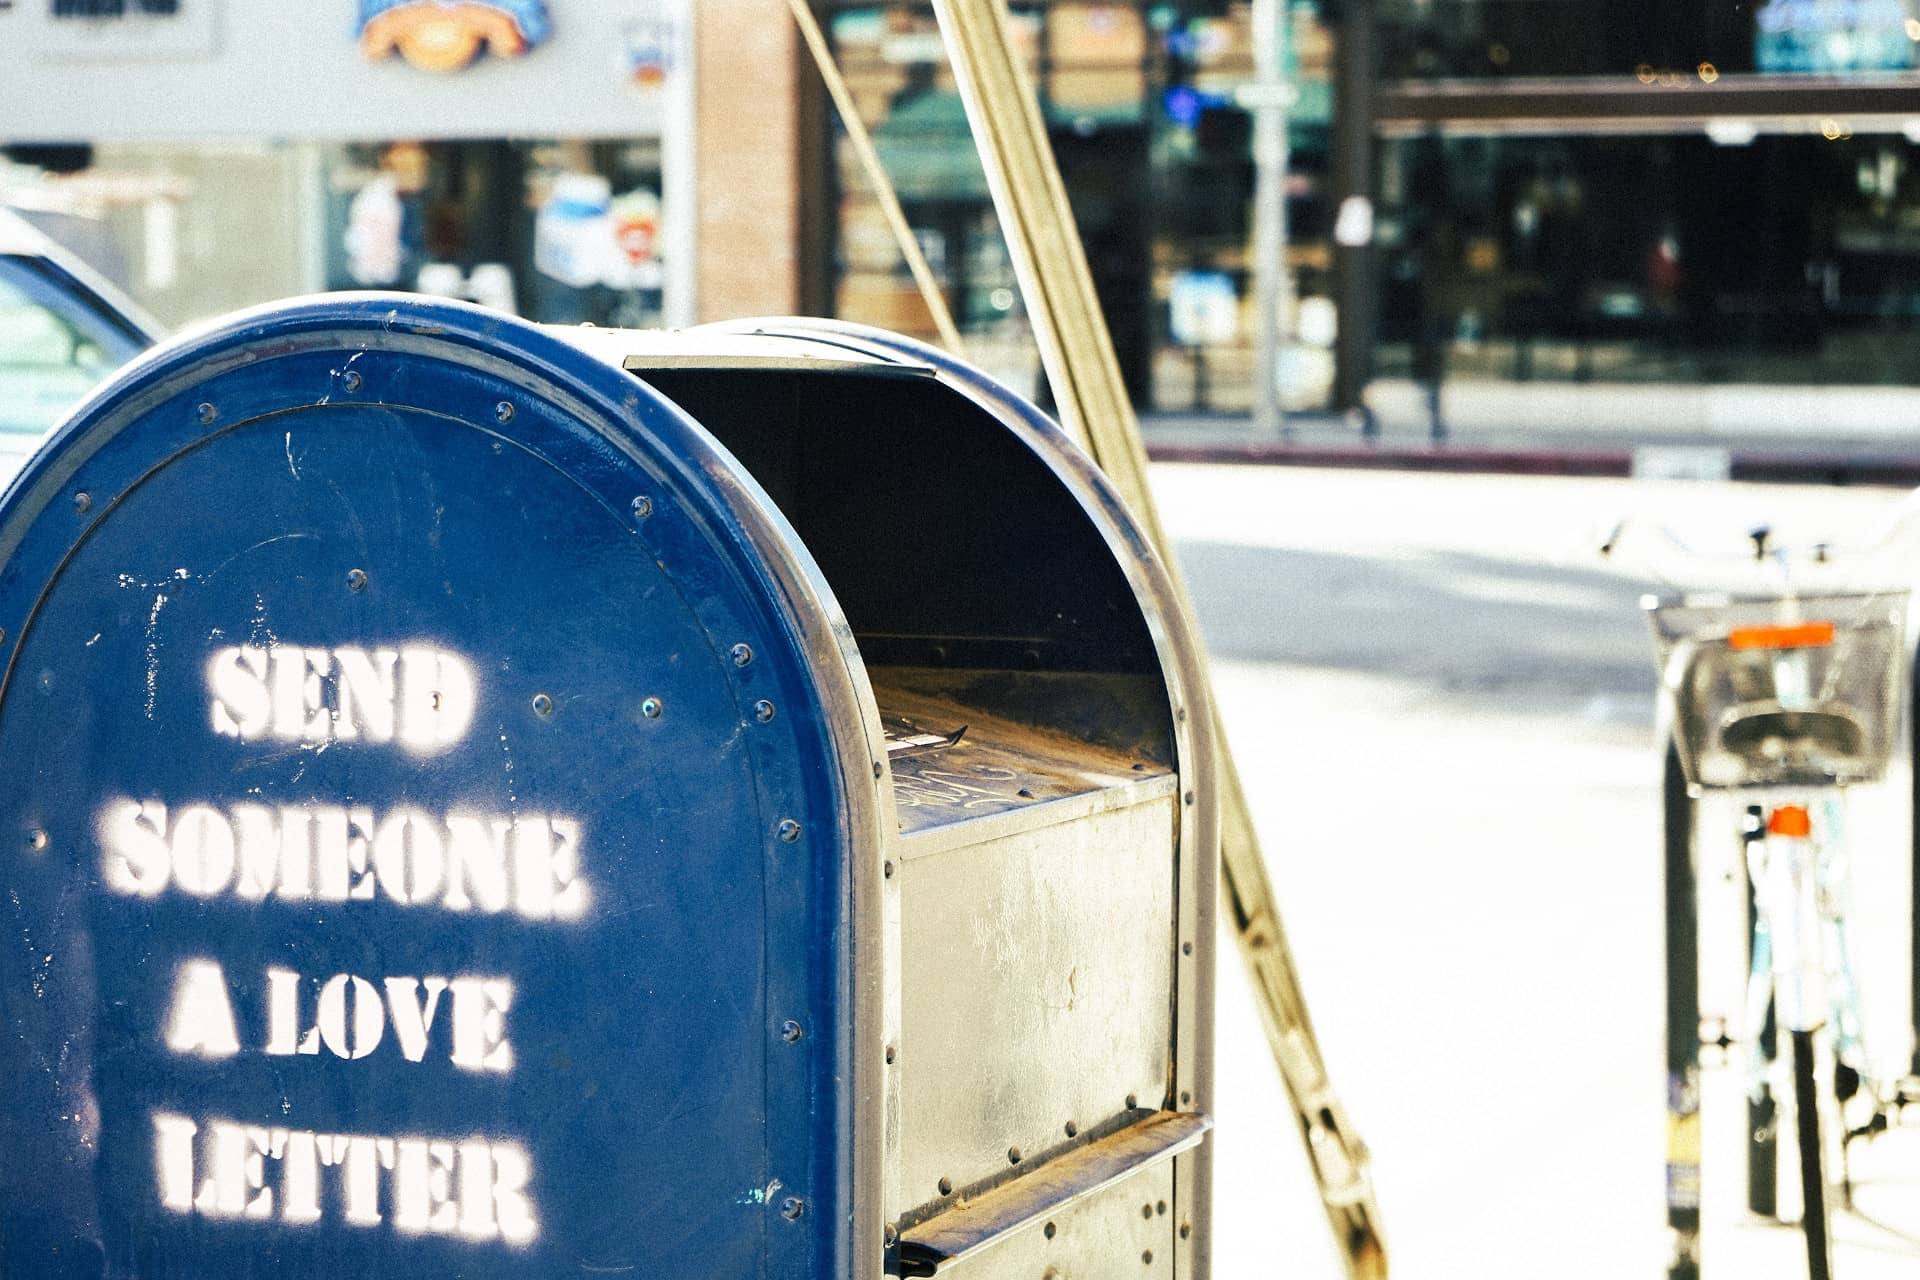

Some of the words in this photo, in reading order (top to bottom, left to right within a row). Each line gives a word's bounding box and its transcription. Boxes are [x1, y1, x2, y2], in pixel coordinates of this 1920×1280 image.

[208, 641, 476, 752] SEND
[101, 798, 591, 920] SOMEONE
[167, 957, 240, 1058] A
[265, 965, 516, 1074] LOVE
[153, 1110, 540, 1245] LETTER
